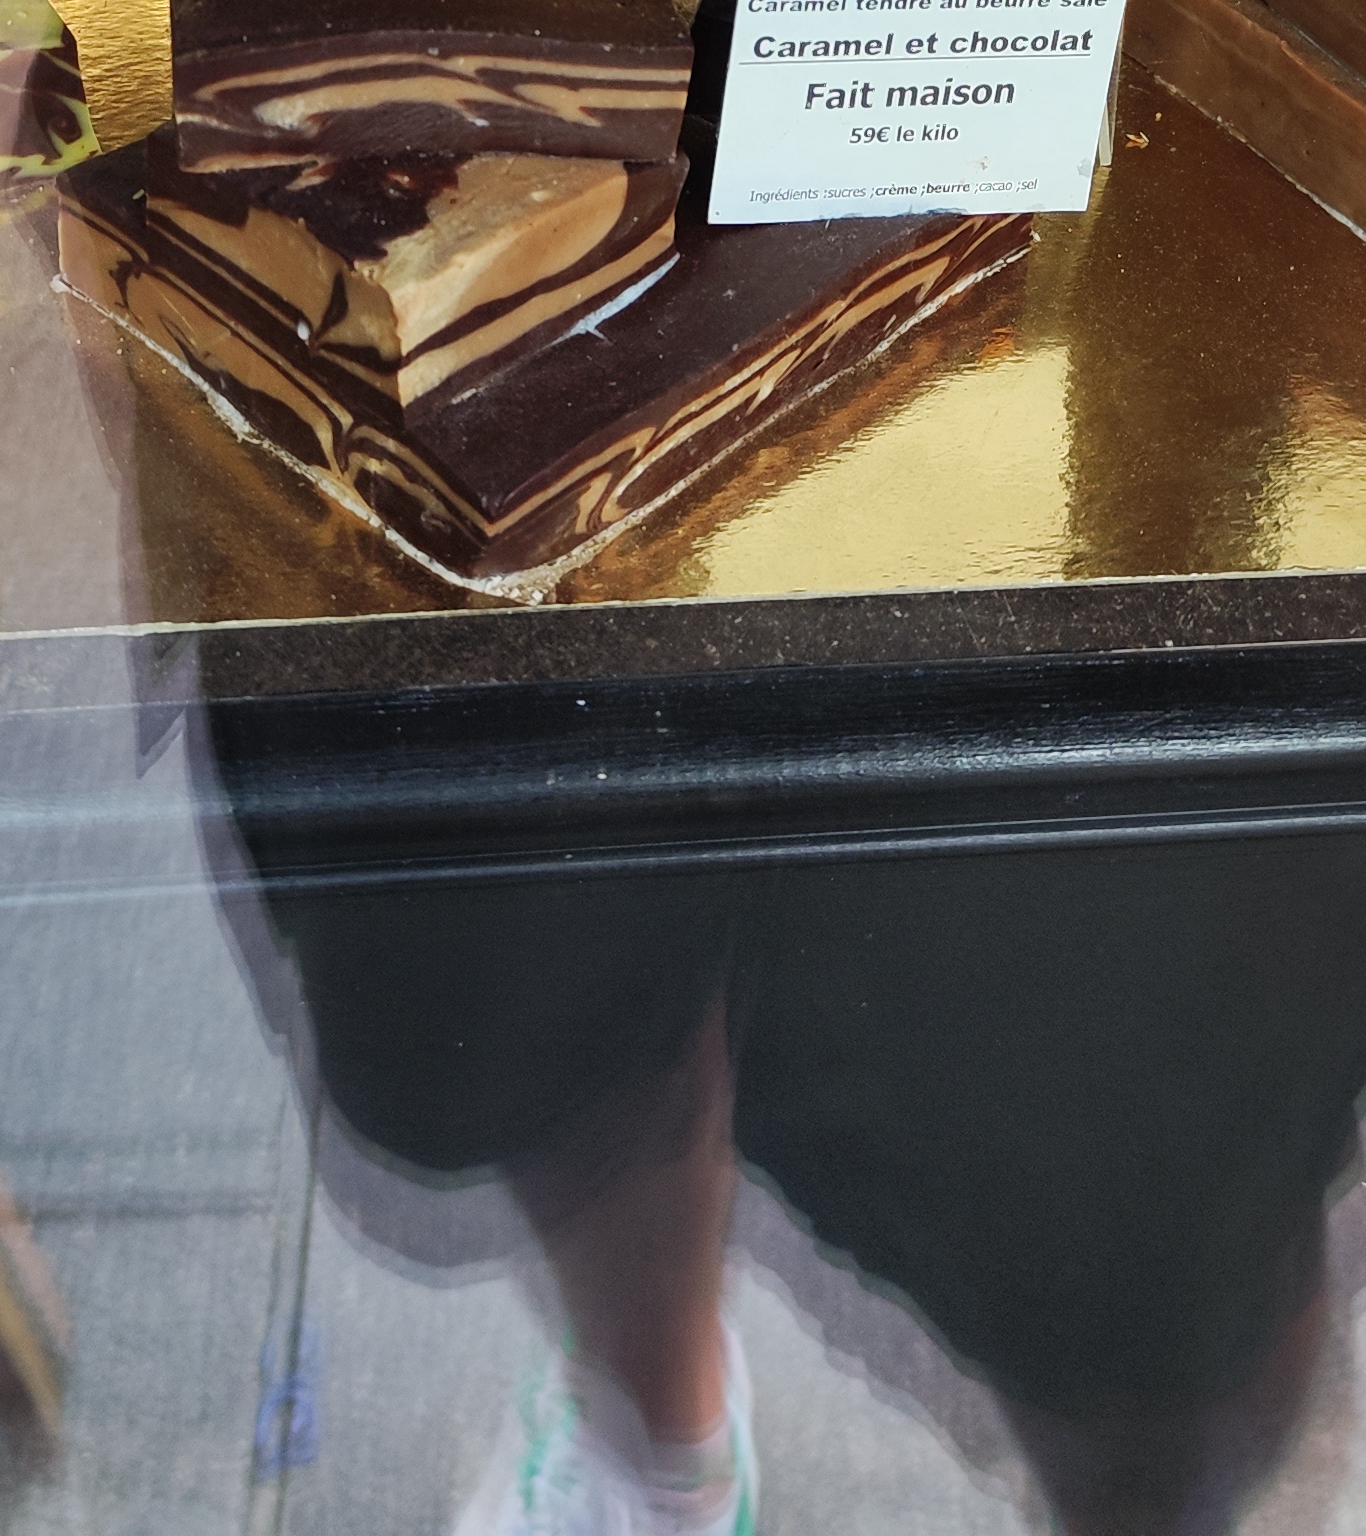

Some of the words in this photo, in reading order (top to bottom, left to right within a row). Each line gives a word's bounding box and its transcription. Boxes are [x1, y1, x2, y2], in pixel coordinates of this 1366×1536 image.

[753, 33, 894, 58] Caramel
[905, 32, 939, 55] et
[949, 29, 1093, 53] chocolat
[804, 81, 875, 110] Fait
[885, 78, 1015, 107] maison
[848, 126, 890, 144] 59€
[896, 125, 915, 142] le
[921, 124, 959, 142] kilo
[750, 188, 818, 204] Ingrédients
